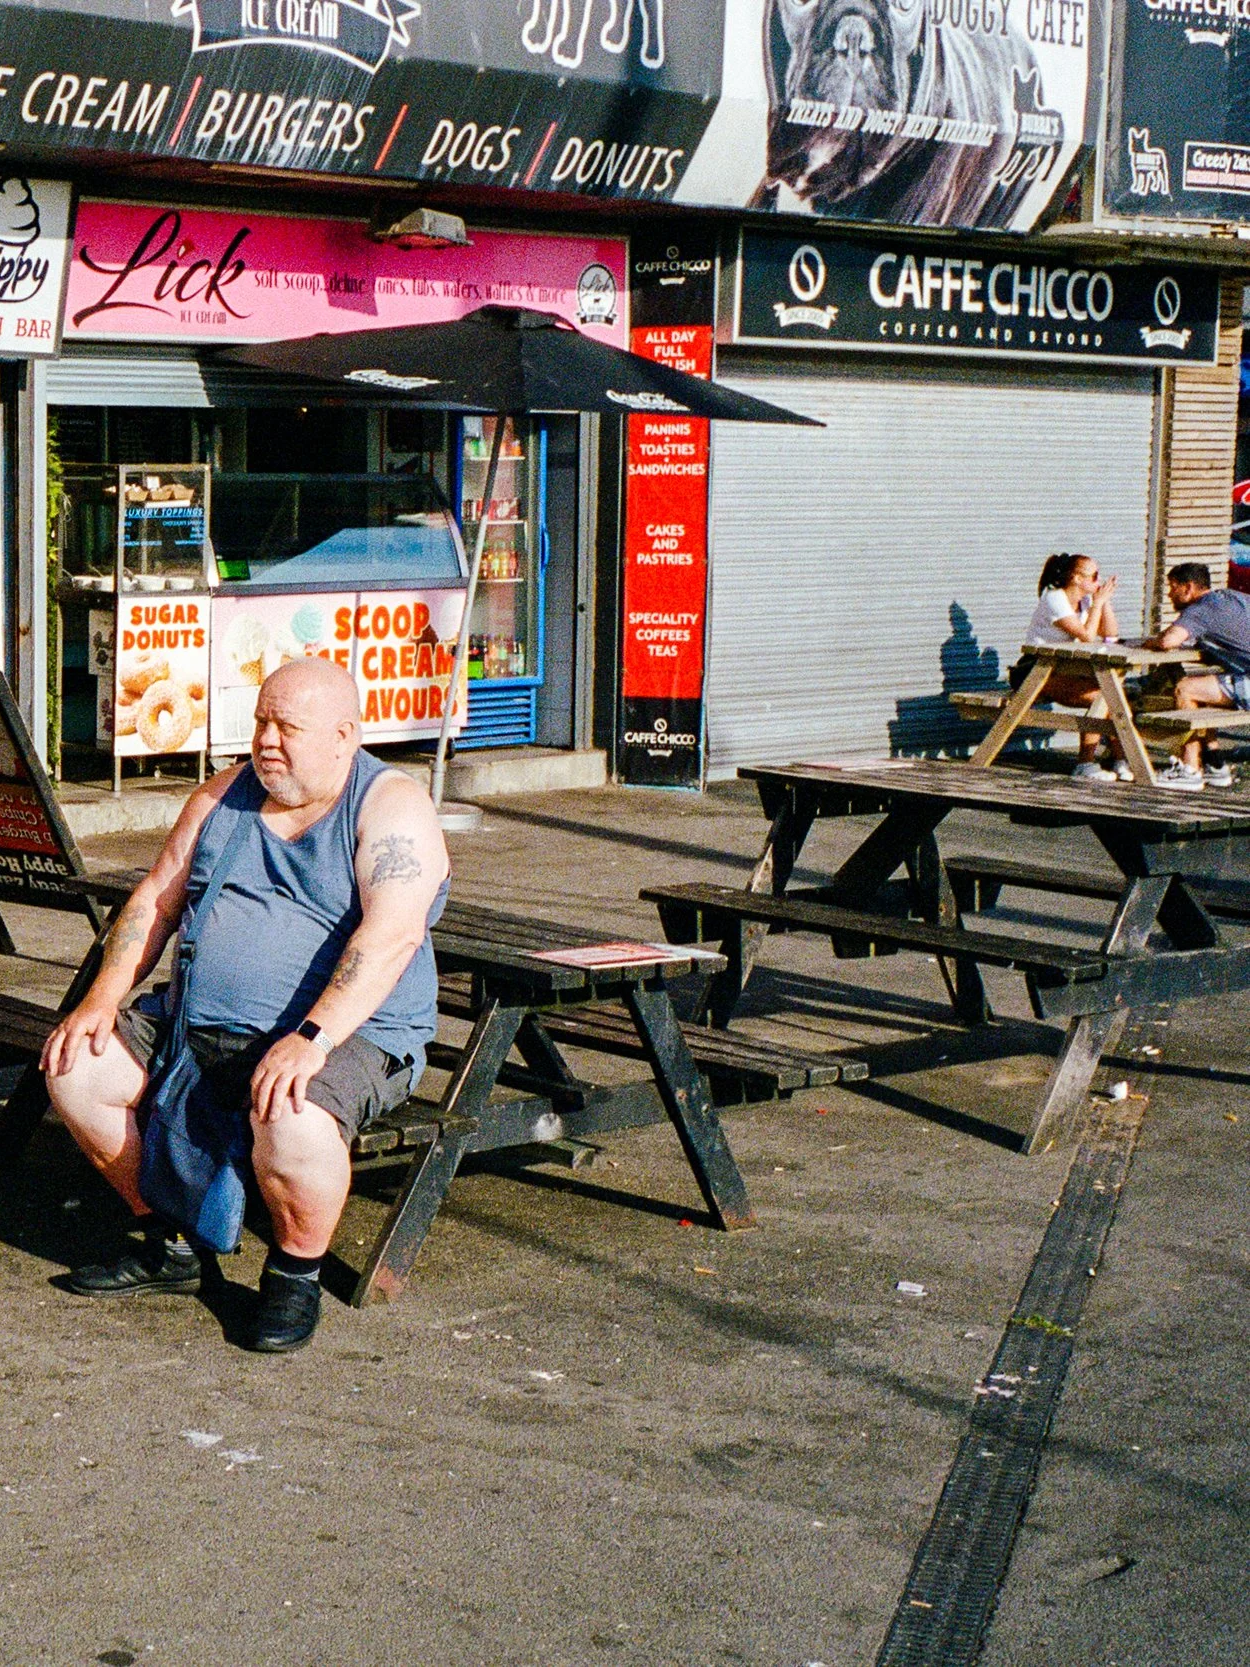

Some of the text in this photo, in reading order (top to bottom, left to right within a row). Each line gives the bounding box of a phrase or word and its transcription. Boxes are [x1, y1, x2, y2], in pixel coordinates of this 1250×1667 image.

[240, 0, 338, 39] ICE CREAM
[931, 0, 1086, 48] DOGGY CAFE
[20, 71, 171, 136] CREAM
[197, 89, 375, 154] BURGERS
[786, 98, 998, 148] TREATS AND DOGGY MENU AVAILABLE
[422, 119, 521, 172] DOGS
[551, 136, 685, 193] DONUTS
[1192, 149, 1232, 174] Greedy
[71, 209, 254, 329] Lick
[635, 260, 711, 273] CAFFE CHICCO
[254, 268, 278, 290] soft
[524, 283, 534, 302] &
[539, 285, 567, 305] more
[869, 252, 1114, 322] CAFFE CHICCO
[14, 317, 52, 339] BAR
[180, 309, 227, 325] ICE CREAM
[645, 331, 697, 344] ALL DAY
[975, 326, 1012, 342] AND
[1029, 330, 1103, 348] BEYOND
[654, 345, 685, 357] FULL
[644, 423, 691, 436] PANINIS
[639, 443, 696, 456] TOASTIES
[629, 463, 706, 476] SANDWICHES
[161, 507, 203, 518] TOPPINGS
[646, 524, 686, 537] CAKES
[652, 538, 679, 551] AND
[637, 553, 693, 567] PASTRIES
[130, 603, 199, 625] SUGAR
[334, 602, 431, 642] SCOOP
[628, 612, 699, 625] SPECIALITY
[122, 629, 205, 651] DONUTS
[635, 629, 691, 642] COFFEES
[647, 645, 678, 657] TEAS
[361, 643, 455, 682] CREAM
[624, 731, 697, 746] CAFFE CHICCO
